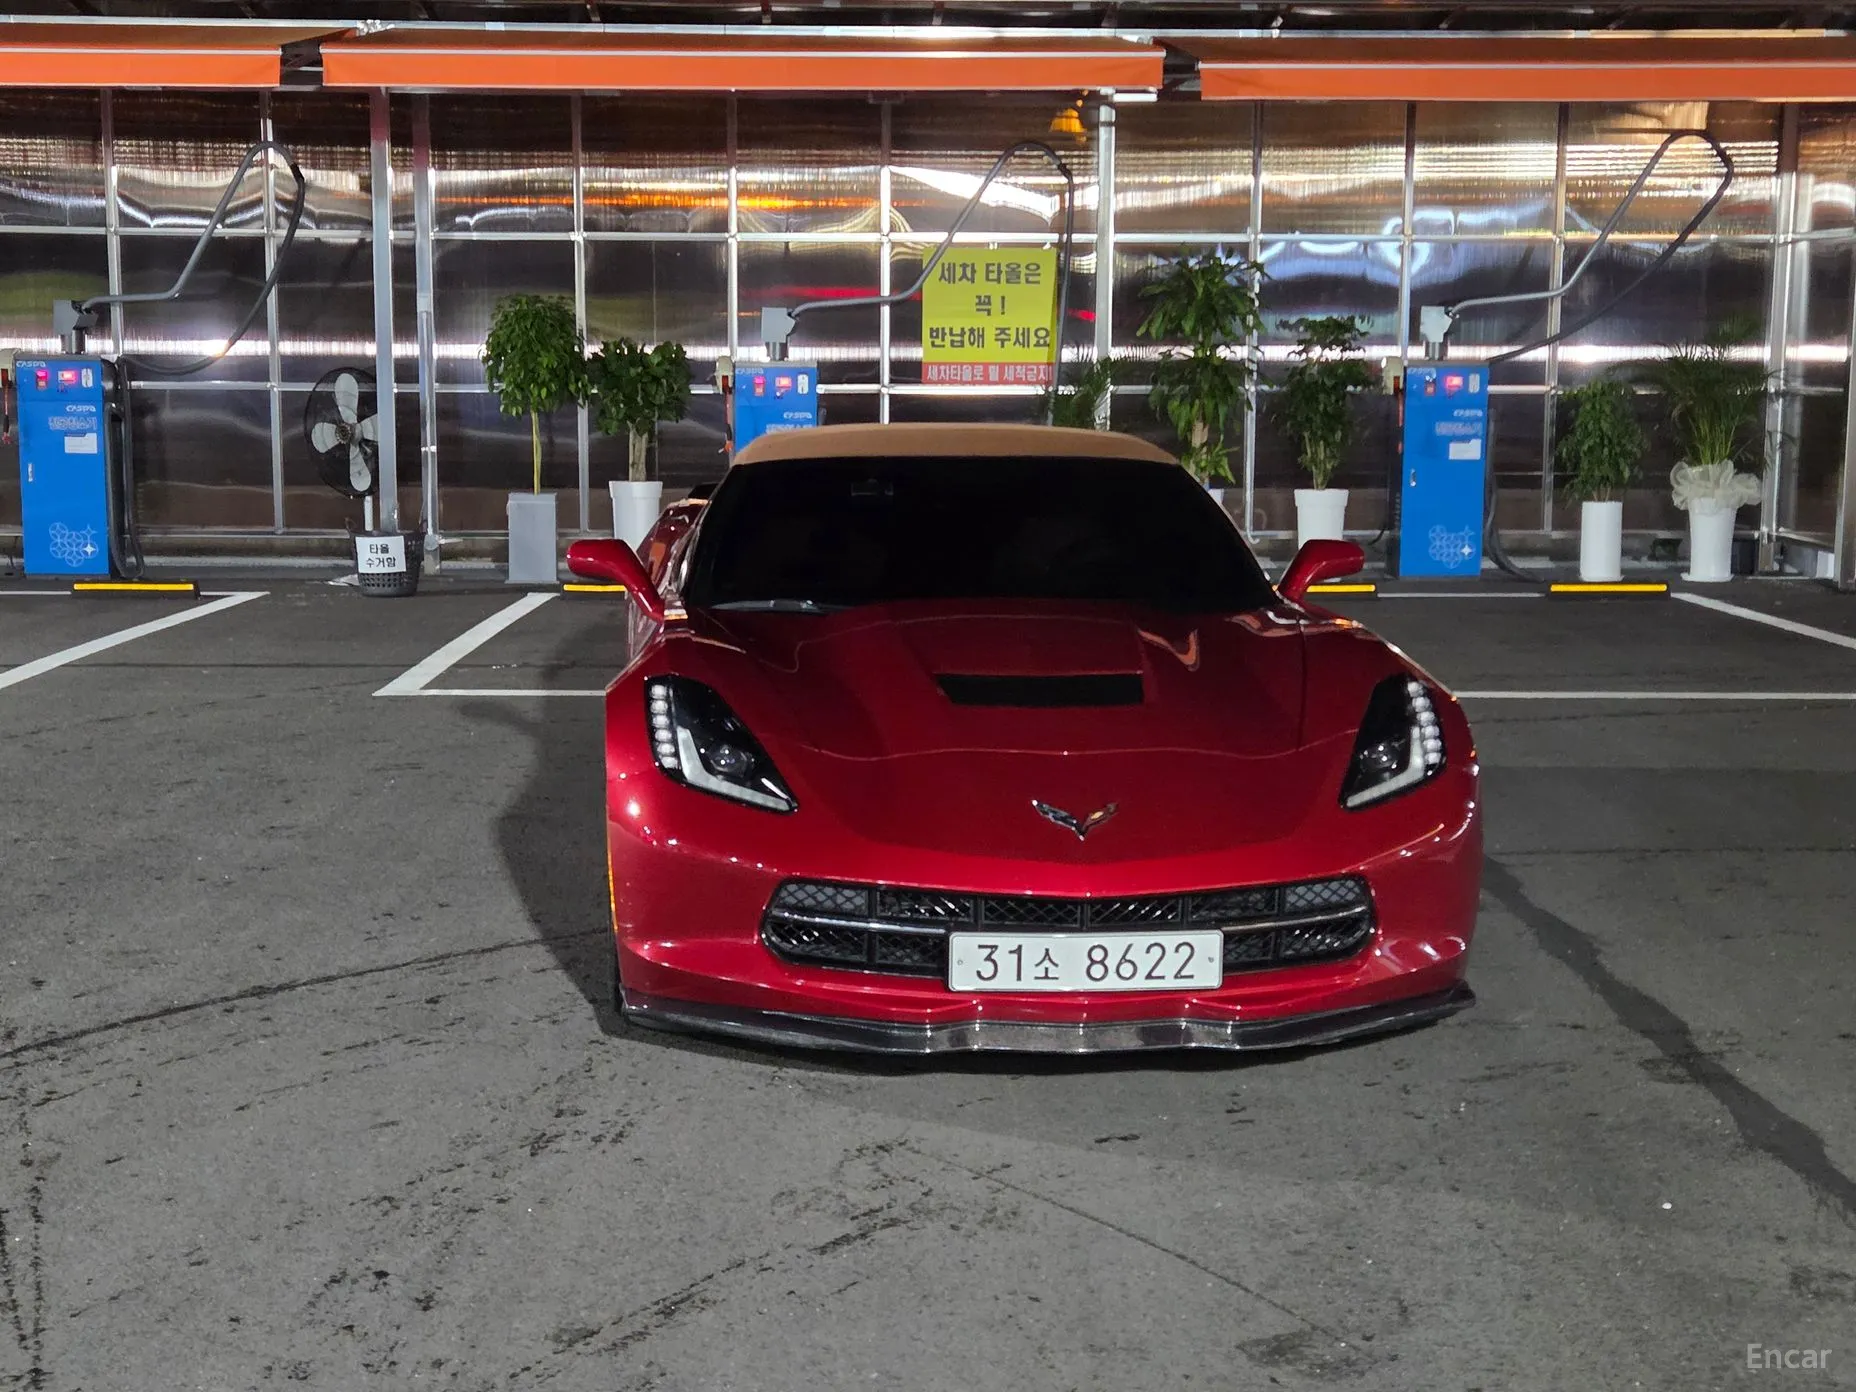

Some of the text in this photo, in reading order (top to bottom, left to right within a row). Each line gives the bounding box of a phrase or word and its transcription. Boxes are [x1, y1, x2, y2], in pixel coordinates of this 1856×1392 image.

[938, 262, 1042, 285] 세차 타올은
[975, 294, 992, 317] 꼭
[929, 326, 1051, 348] 반납해 주세요
[369, 543, 390, 555] 타올
[365, 556, 397, 568] 수거함
[976, 941, 1196, 982] 31소 8622
